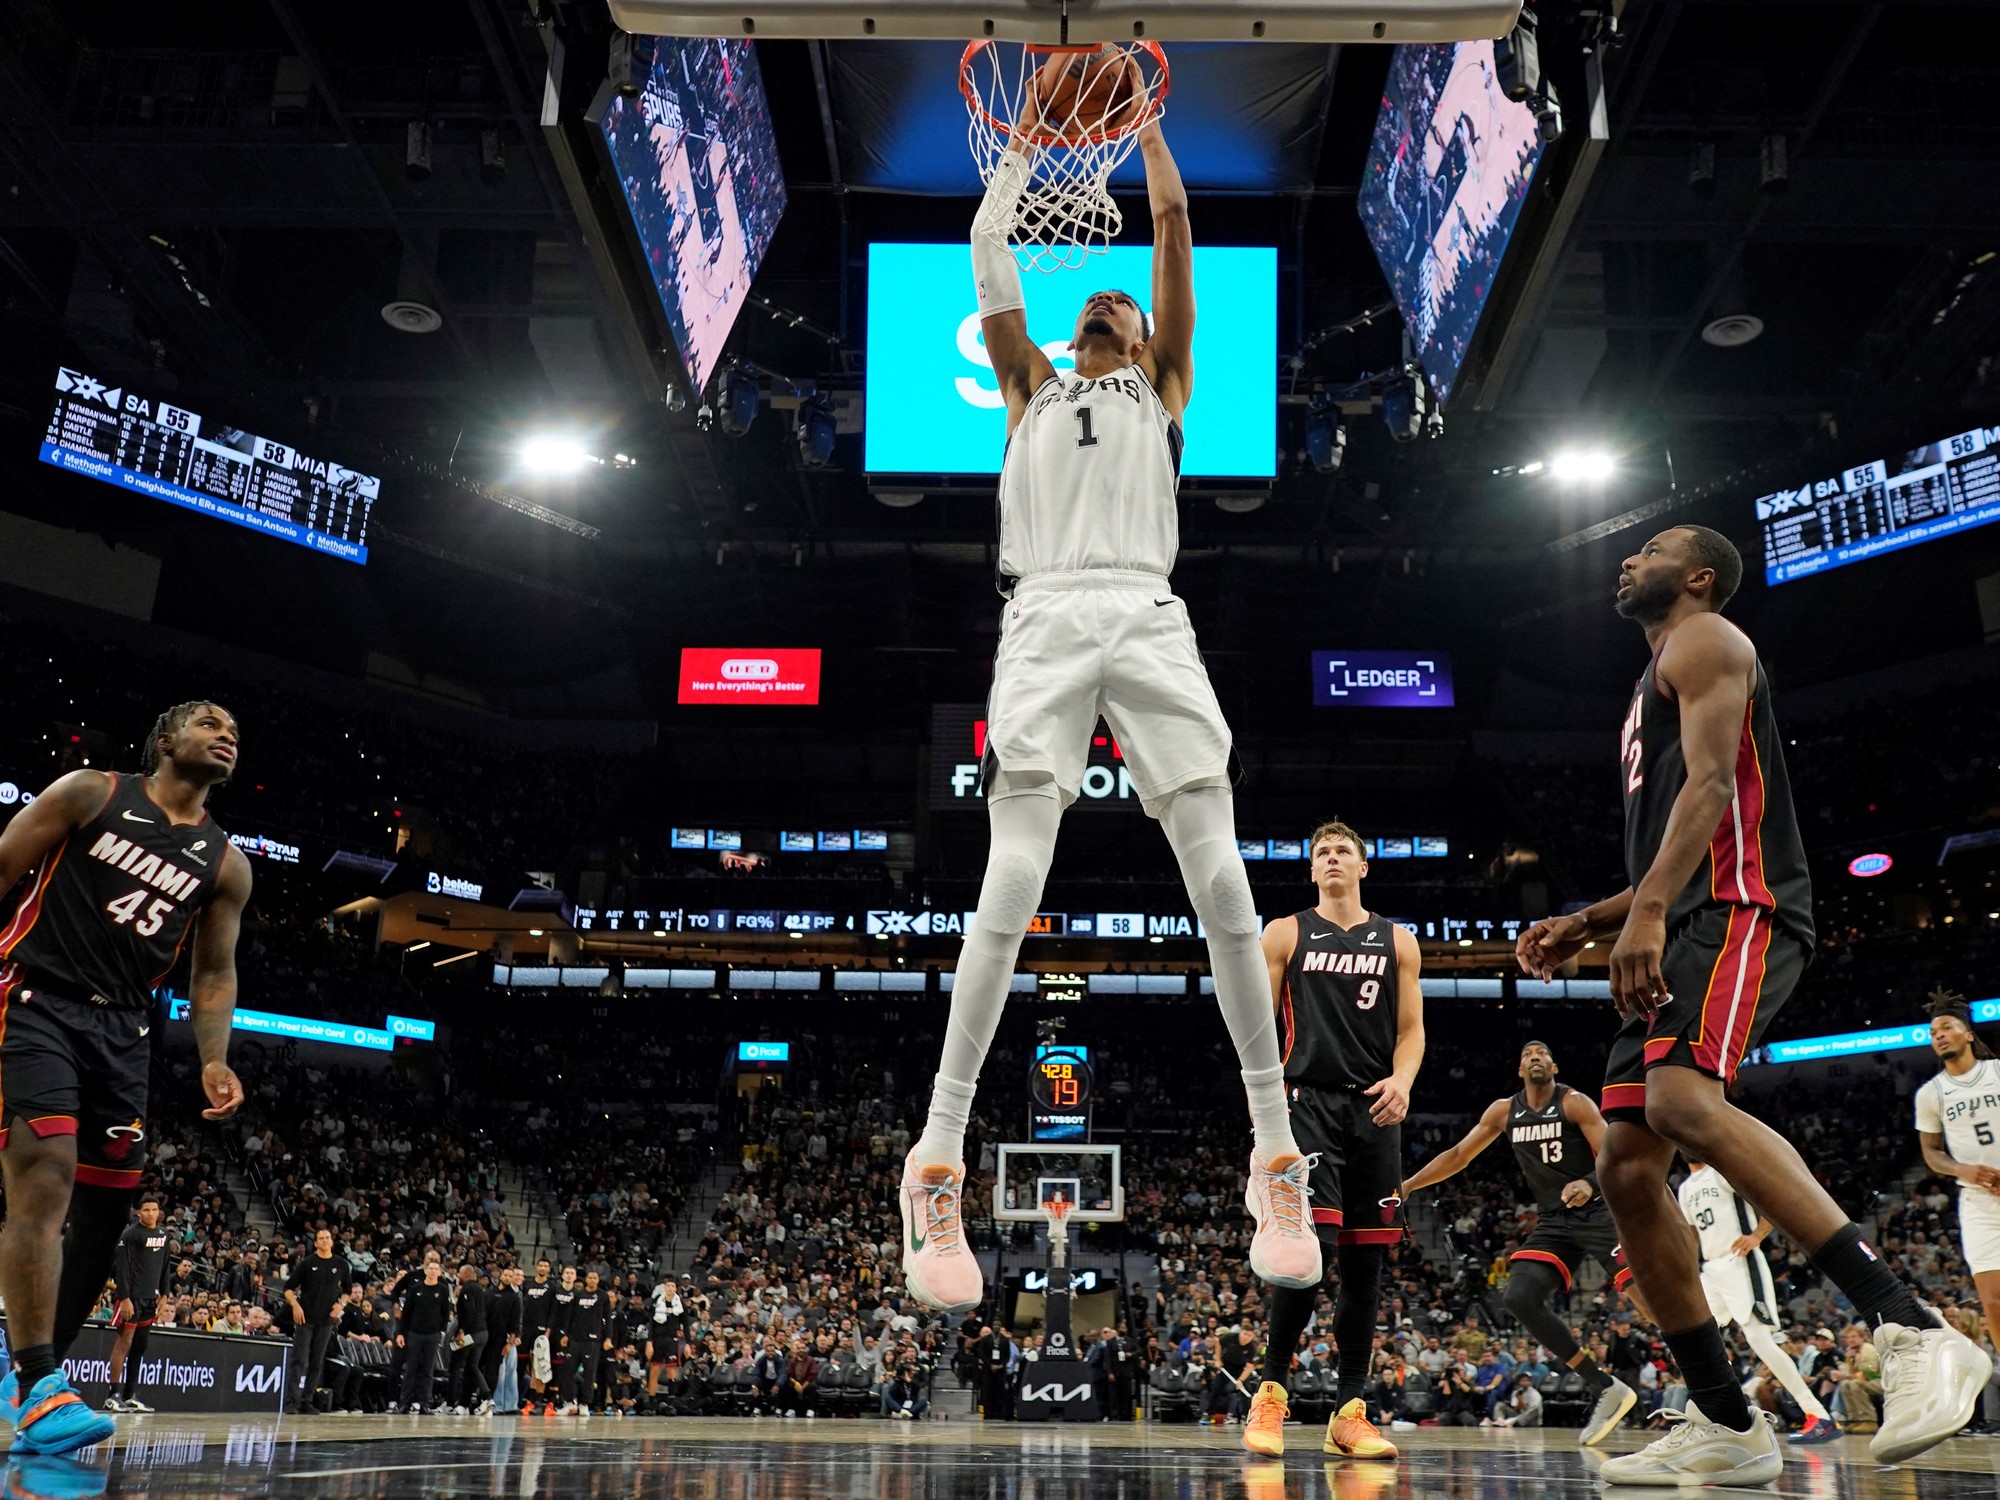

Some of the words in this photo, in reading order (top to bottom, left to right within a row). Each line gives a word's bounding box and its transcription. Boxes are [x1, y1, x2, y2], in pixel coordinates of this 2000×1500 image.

[68, 401, 117, 425] WEMBANYAMA
[125, 394, 149, 416] SA
[63, 420, 92, 436] CASTLE
[65, 410, 96, 428] HARPER
[165, 407, 189, 430] 55
[1075, 406, 1099, 449] 1
[61, 429, 93, 447] VASSELL
[1950, 434, 1974, 455] 58
[263, 442, 285, 463] 58
[64, 453, 112, 476] Methodist
[293, 453, 325, 478] MIA
[265, 469, 297, 487] LARSSON
[1853, 465, 1875, 486] 55
[262, 487, 293, 504] ADEBAYO
[1815, 478, 1840, 497] SA
[123, 473, 134, 483] 10
[134, 478, 197, 504] neighborhood
[198, 497, 215, 510] ERs
[216, 505, 244, 520] across
[245, 513, 261, 525] San
[262, 519, 297, 536] Antonio
[259, 504, 291, 522] MITCHELL
[261, 495, 291, 512] WIGGINS
[316, 535, 358, 555] Methodist
[1848, 534, 1906, 556] neighborhood
[1928, 519, 1958, 534] across
[1959, 514, 1977, 525] San
[692, 681, 714, 691] Here
[716, 681, 774, 693] Everything's
[775, 681, 806, 691] Better
[1344, 669, 1421, 687] LEDGER
[230, 834, 258, 849] ONE
[265, 840, 300, 857] STAR
[88, 831, 201, 901] MIAMI
[442, 876, 483, 894] beldon
[107, 889, 175, 937] 45
[578, 909, 597, 918] REB
[605, 910, 624, 919] AST
[660, 911, 678, 919] BLK
[688, 914, 709, 927] TO
[736, 914, 774, 928] FG%
[814, 916, 834, 928] PF
[846, 915, 854, 930] 4
[931, 916, 961, 934] SA
[1026, 916, 1051, 933] 3.1
[1112, 918, 1130, 933] 58
[1149, 916, 1192, 935] MIA
[1502, 920, 1521, 928] AST
[1303, 952, 1387, 975] MIAMI
[1356, 980, 1380, 1010] 9
[243, 1016, 269, 1028] Spurs
[278, 1021, 300, 1032] Frost
[302, 1023, 324, 1035] Debit
[326, 1027, 345, 1039] Card
[406, 1023, 426, 1035] Frost
[366, 1032, 389, 1046] Frost
[1041, 1064, 1072, 1079] 42.8
[1054, 1079, 1078, 1105] 19
[1946, 1094, 2000, 1121] SPUR
[1049, 1115, 1086, 1125] TISSOT
[1512, 1121, 1562, 1143] MIAMI
[1974, 1121, 1994, 1146] 5
[1540, 1140, 1563, 1164] 13
[1696, 1208, 1714, 1231] 30
[145, 1235, 167, 1248] HEAT
[1046, 1346, 1070, 1355] Frost
[166, 1359, 214, 1394] Inspires
[235, 1364, 282, 1393] KIA
[1022, 1383, 1092, 1401] KIA
